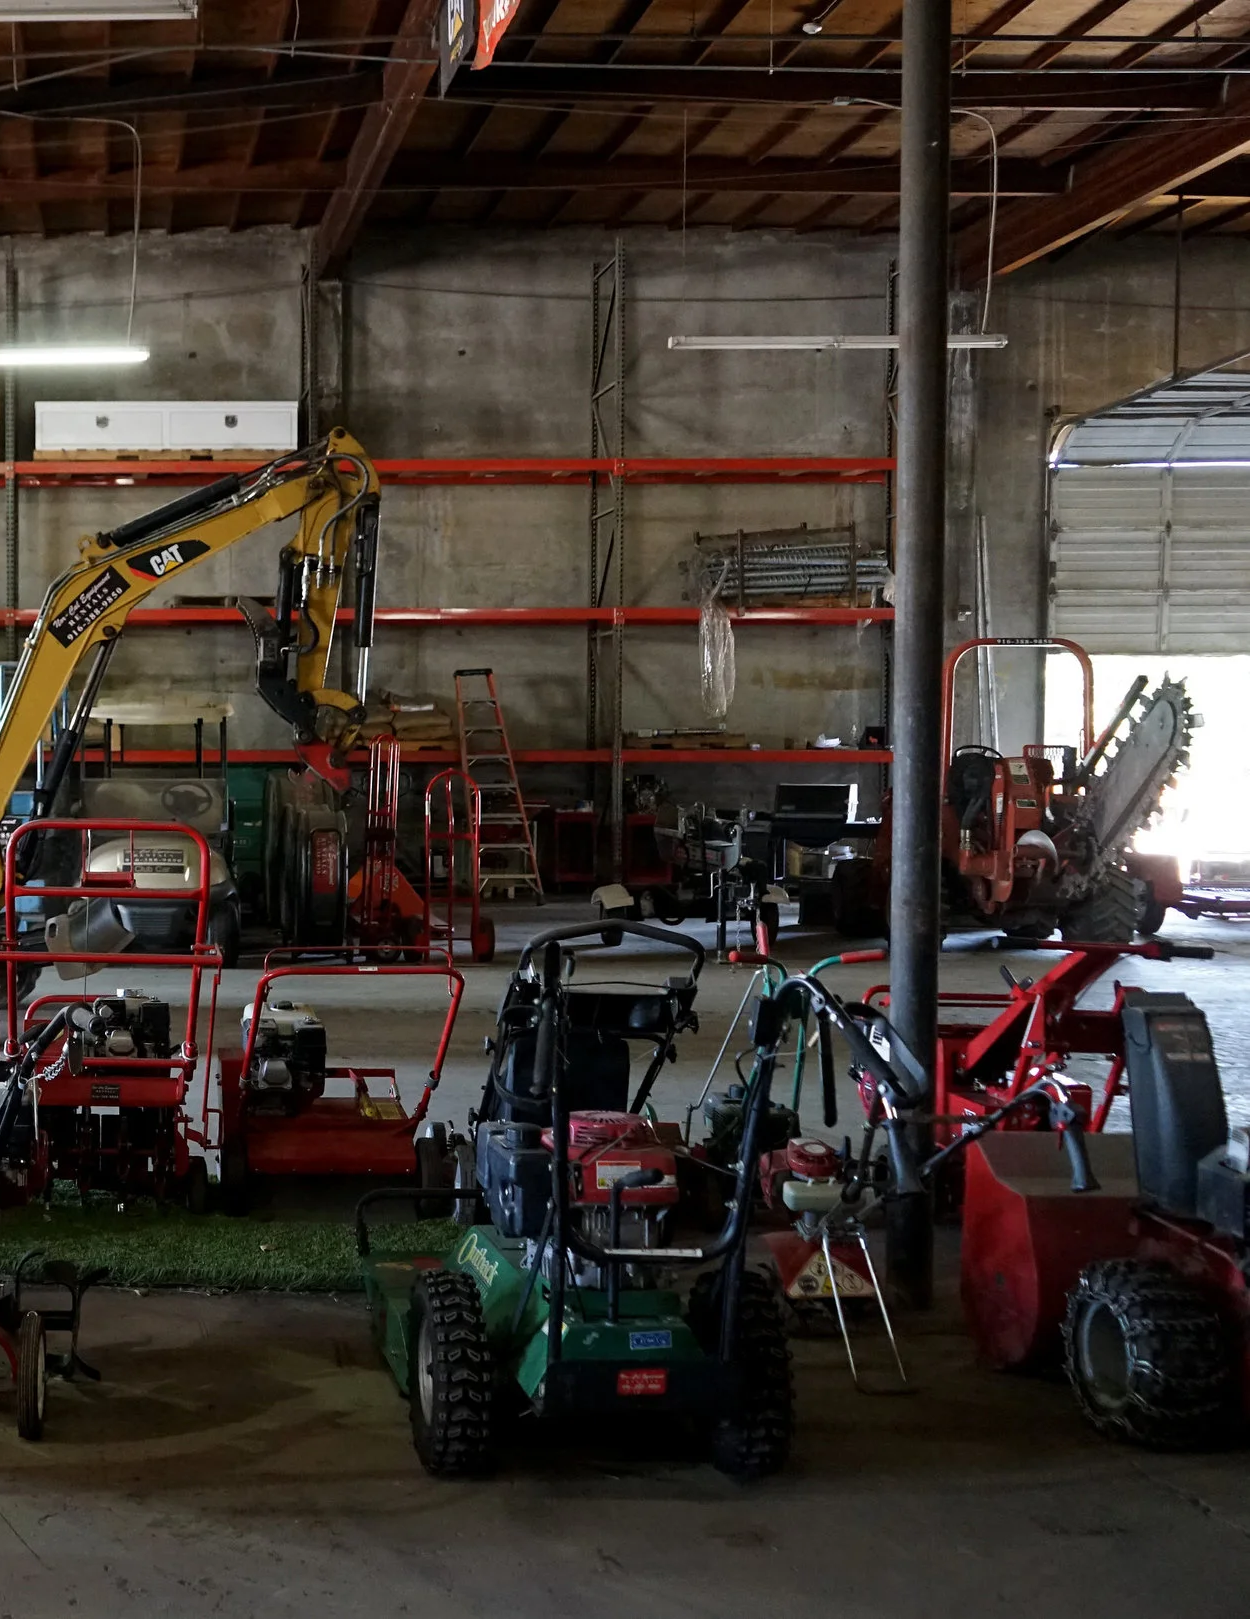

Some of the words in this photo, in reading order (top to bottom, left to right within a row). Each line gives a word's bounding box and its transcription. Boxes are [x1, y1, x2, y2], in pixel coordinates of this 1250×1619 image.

[149, 544, 184, 576] CAT
[52, 600, 81, 628] Nor-Cal
[79, 572, 110, 604] Equipment
[67, 588, 122, 640] 916-388-9850
[68, 587, 109, 627] RENTALS
[458, 1234, 499, 1287] Outback
